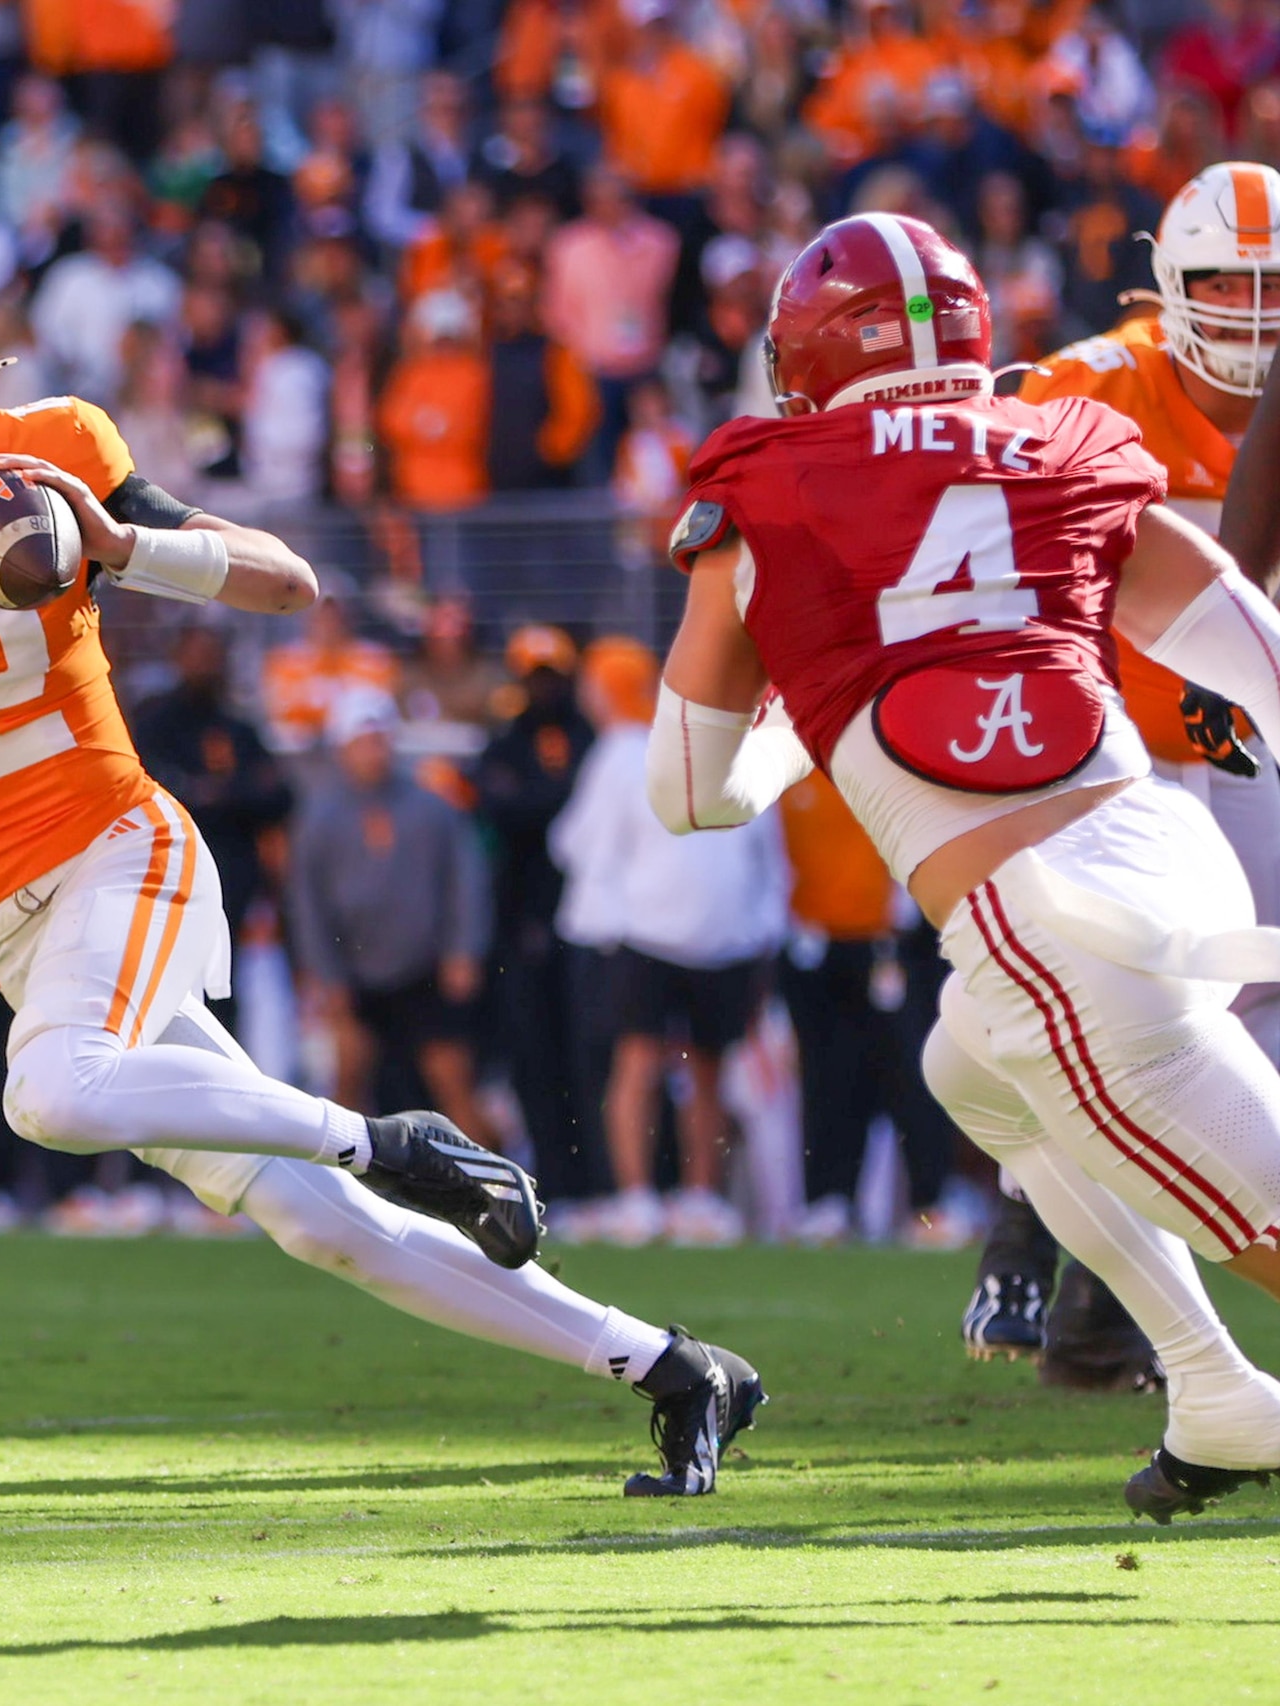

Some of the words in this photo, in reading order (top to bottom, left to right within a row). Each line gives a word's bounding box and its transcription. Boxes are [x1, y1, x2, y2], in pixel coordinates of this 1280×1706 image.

[908, 302, 931, 314] C2P
[863, 379, 947, 402] CRIMSON
[870, 407, 1035, 472] METZ
[877, 484, 1040, 647] 4
[949, 672, 1044, 763] A
